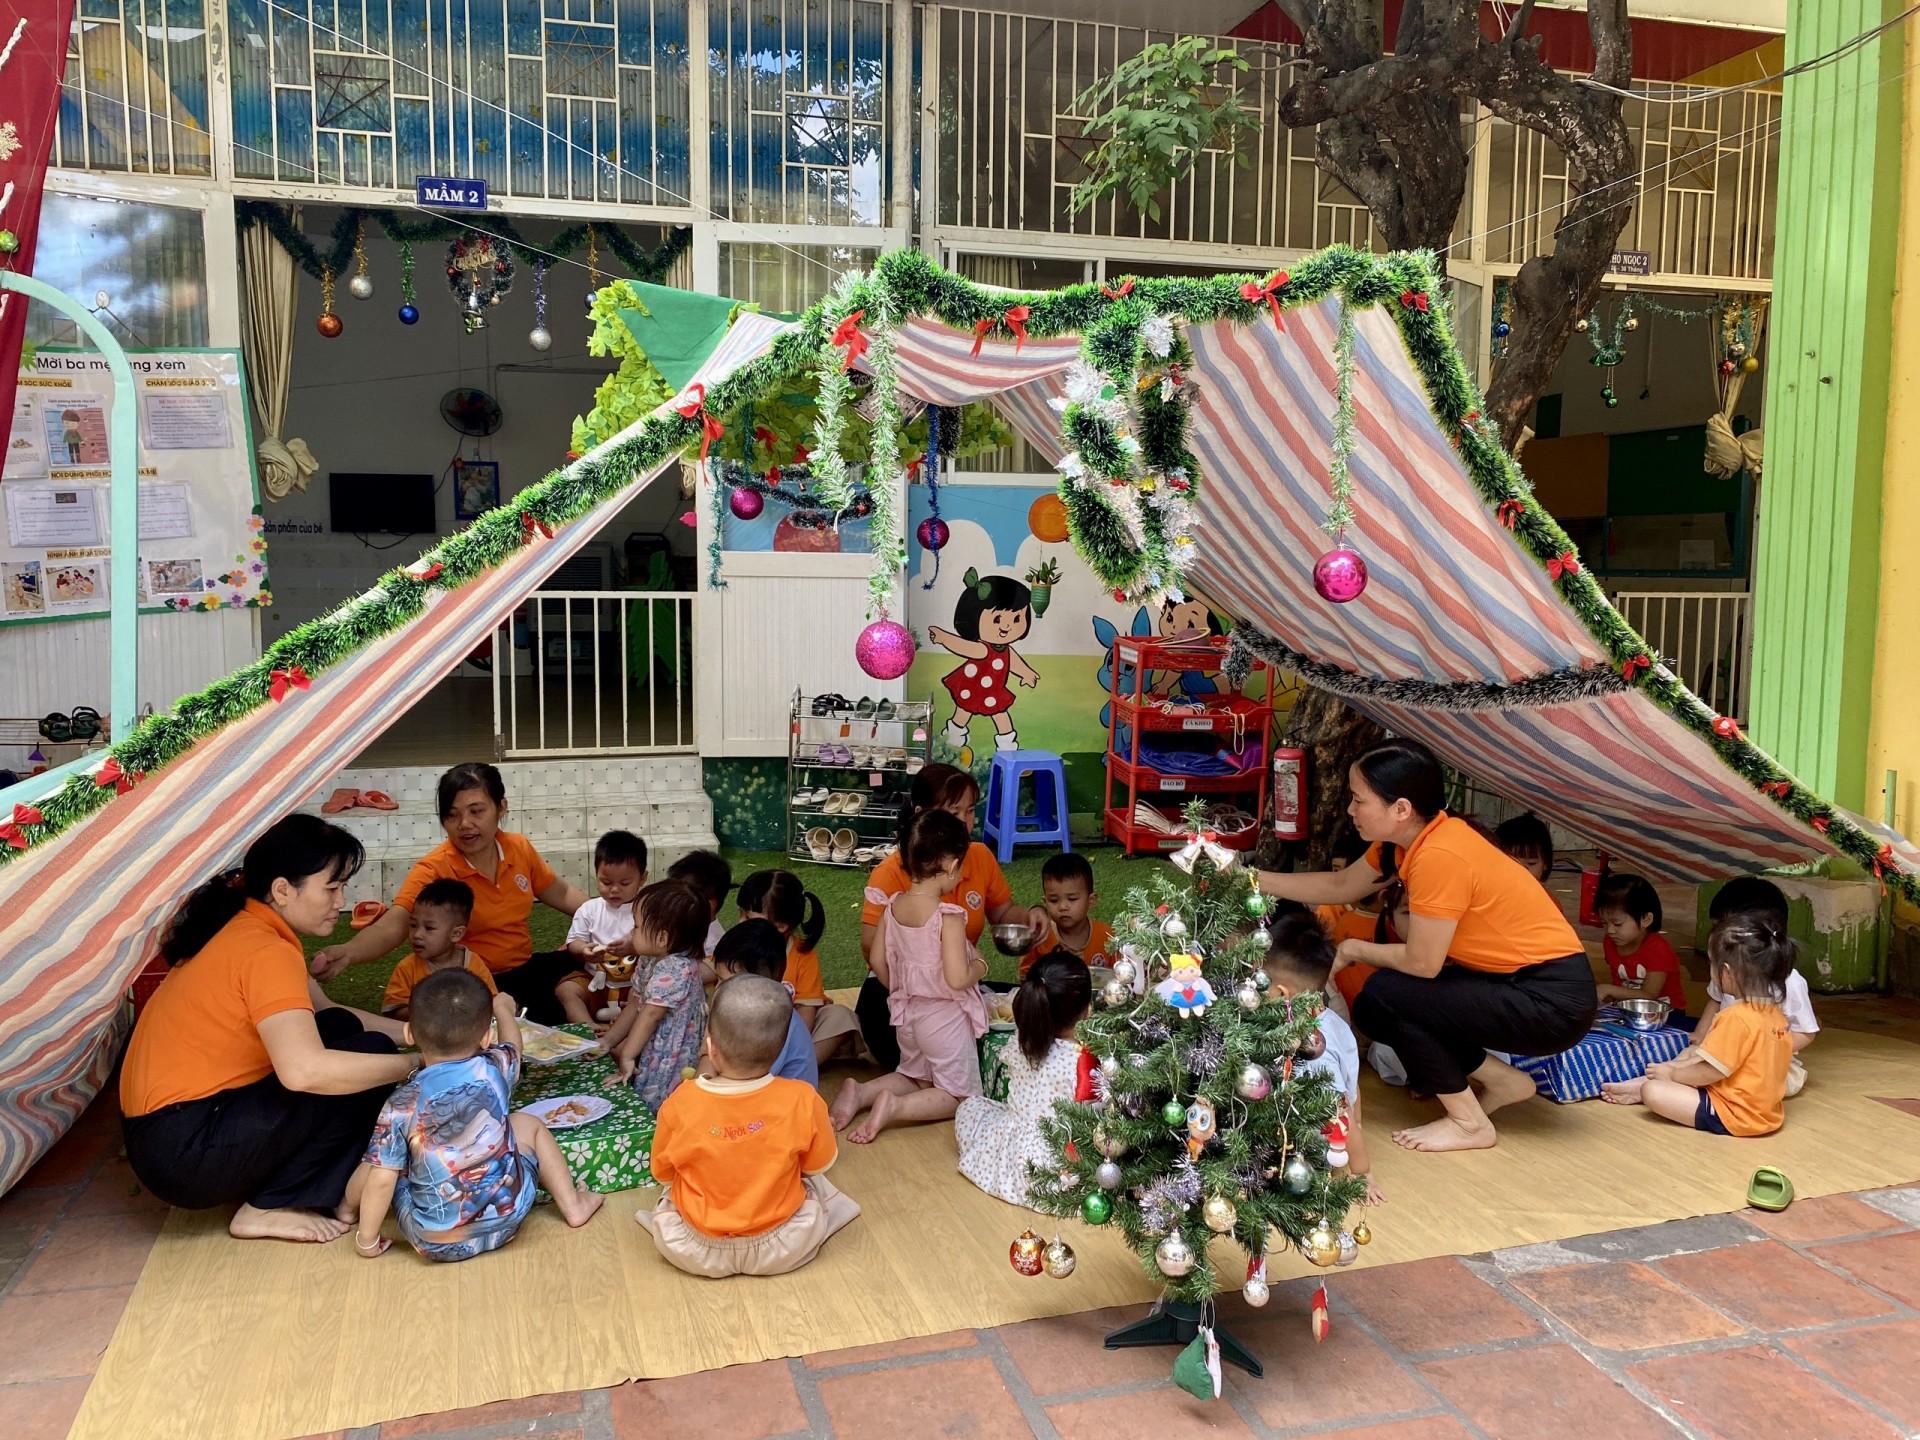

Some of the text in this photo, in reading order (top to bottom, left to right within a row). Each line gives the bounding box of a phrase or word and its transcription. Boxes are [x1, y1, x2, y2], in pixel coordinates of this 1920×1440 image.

[424, 182, 479, 203] MẦM 2
[1622, 254, 1642, 267] NGỌC
[1642, 256, 1648, 266] 2
[1627, 265, 1644, 274] Tháng
[37, 357, 62, 369] Mời
[65, 358, 86, 370] ba
[90, 360, 111, 372] mẹ
[155, 361, 186, 370] xem
[24, 379, 38, 387] SÓC
[39, 379, 53, 387] SỨC
[277, 519, 298, 534] phẩm
[298, 520, 313, 533] của
[313, 521, 323, 533] bé
[747, 1120, 764, 1133] Sao
